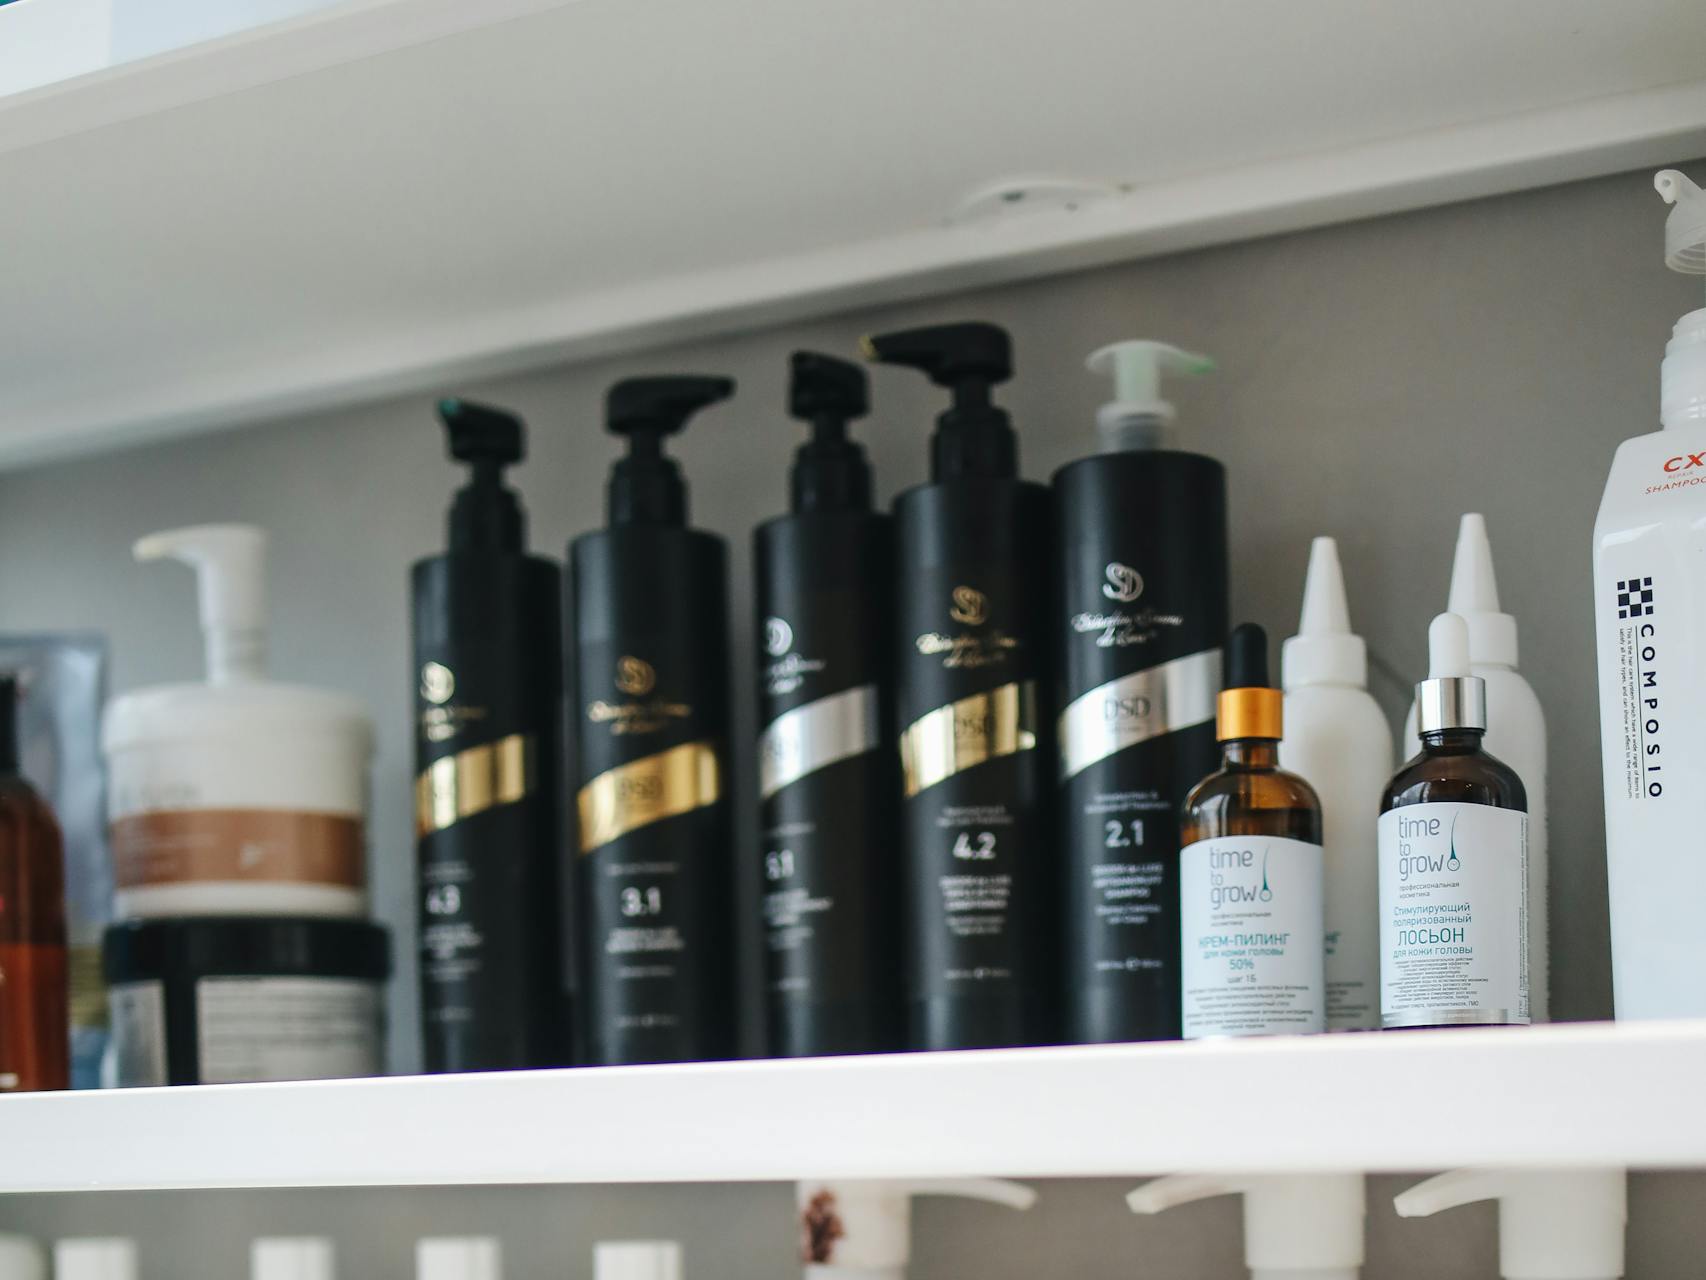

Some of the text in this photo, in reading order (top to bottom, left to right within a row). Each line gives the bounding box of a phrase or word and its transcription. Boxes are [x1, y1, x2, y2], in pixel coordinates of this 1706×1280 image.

[1663, 452, 1706, 472] CX
[1641, 623, 1663, 798] COMPOSIO
[1105, 819, 1144, 848] 2.1
[1399, 815, 1441, 839] time
[952, 831, 996, 860] 4.2
[1399, 840, 1411, 857] to
[1209, 846, 1254, 870] time
[1399, 854, 1444, 882] grow
[1210, 870, 1224, 887] to
[1210, 884, 1257, 910] grow
[1393, 902, 1471, 916] Стимулирующий
[1392, 914, 1473, 927] поляризованный
[1199, 932, 1291, 950] КРЕМ-ПИЛИНГ
[1397, 927, 1465, 946] ЛОСЬОН
[1408, 948, 1433, 957] кожи
[1434, 946, 1473, 955] головы
[1229, 958, 1255, 971] 50%
